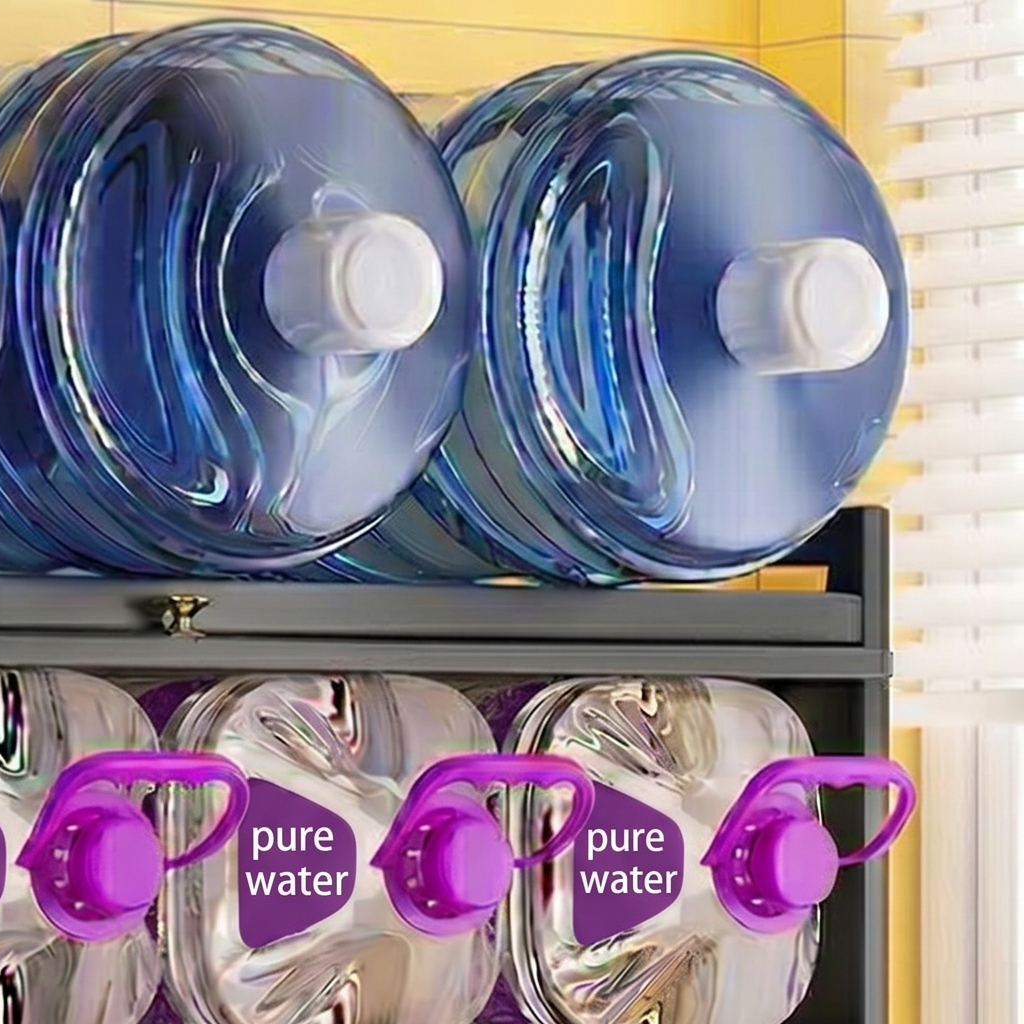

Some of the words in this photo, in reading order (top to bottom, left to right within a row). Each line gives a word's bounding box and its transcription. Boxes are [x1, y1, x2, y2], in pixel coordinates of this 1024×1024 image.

[253, 826, 334, 861] pure
[588, 828, 665, 861] pure
[245, 867, 349, 896] water
[580, 866, 678, 894] water
